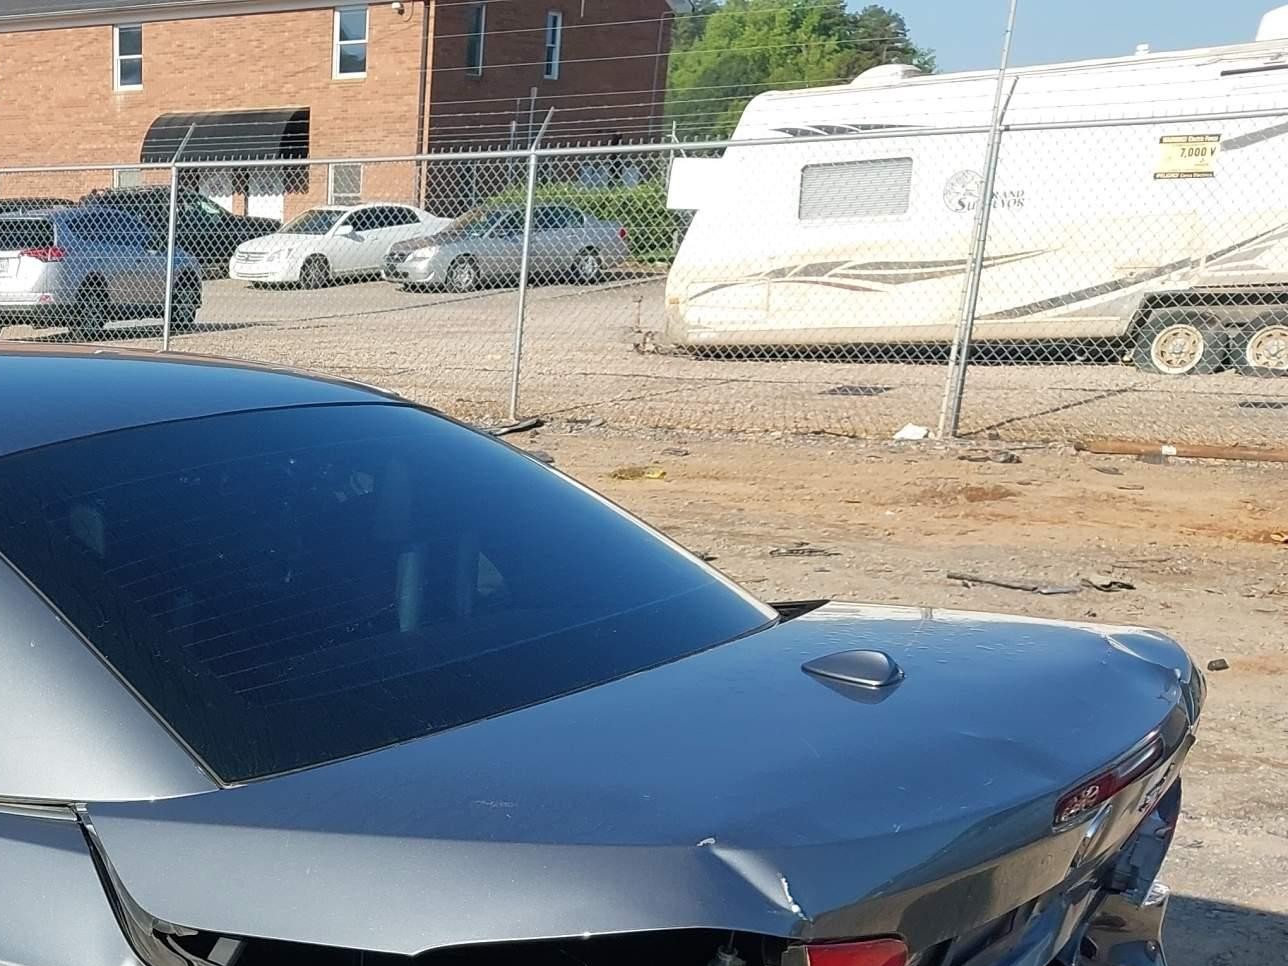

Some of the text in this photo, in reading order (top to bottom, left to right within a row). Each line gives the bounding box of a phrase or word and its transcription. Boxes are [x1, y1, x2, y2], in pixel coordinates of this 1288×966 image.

[1180, 146, 1216, 158] 7,000 V
[992, 189, 1025, 199] RAND
